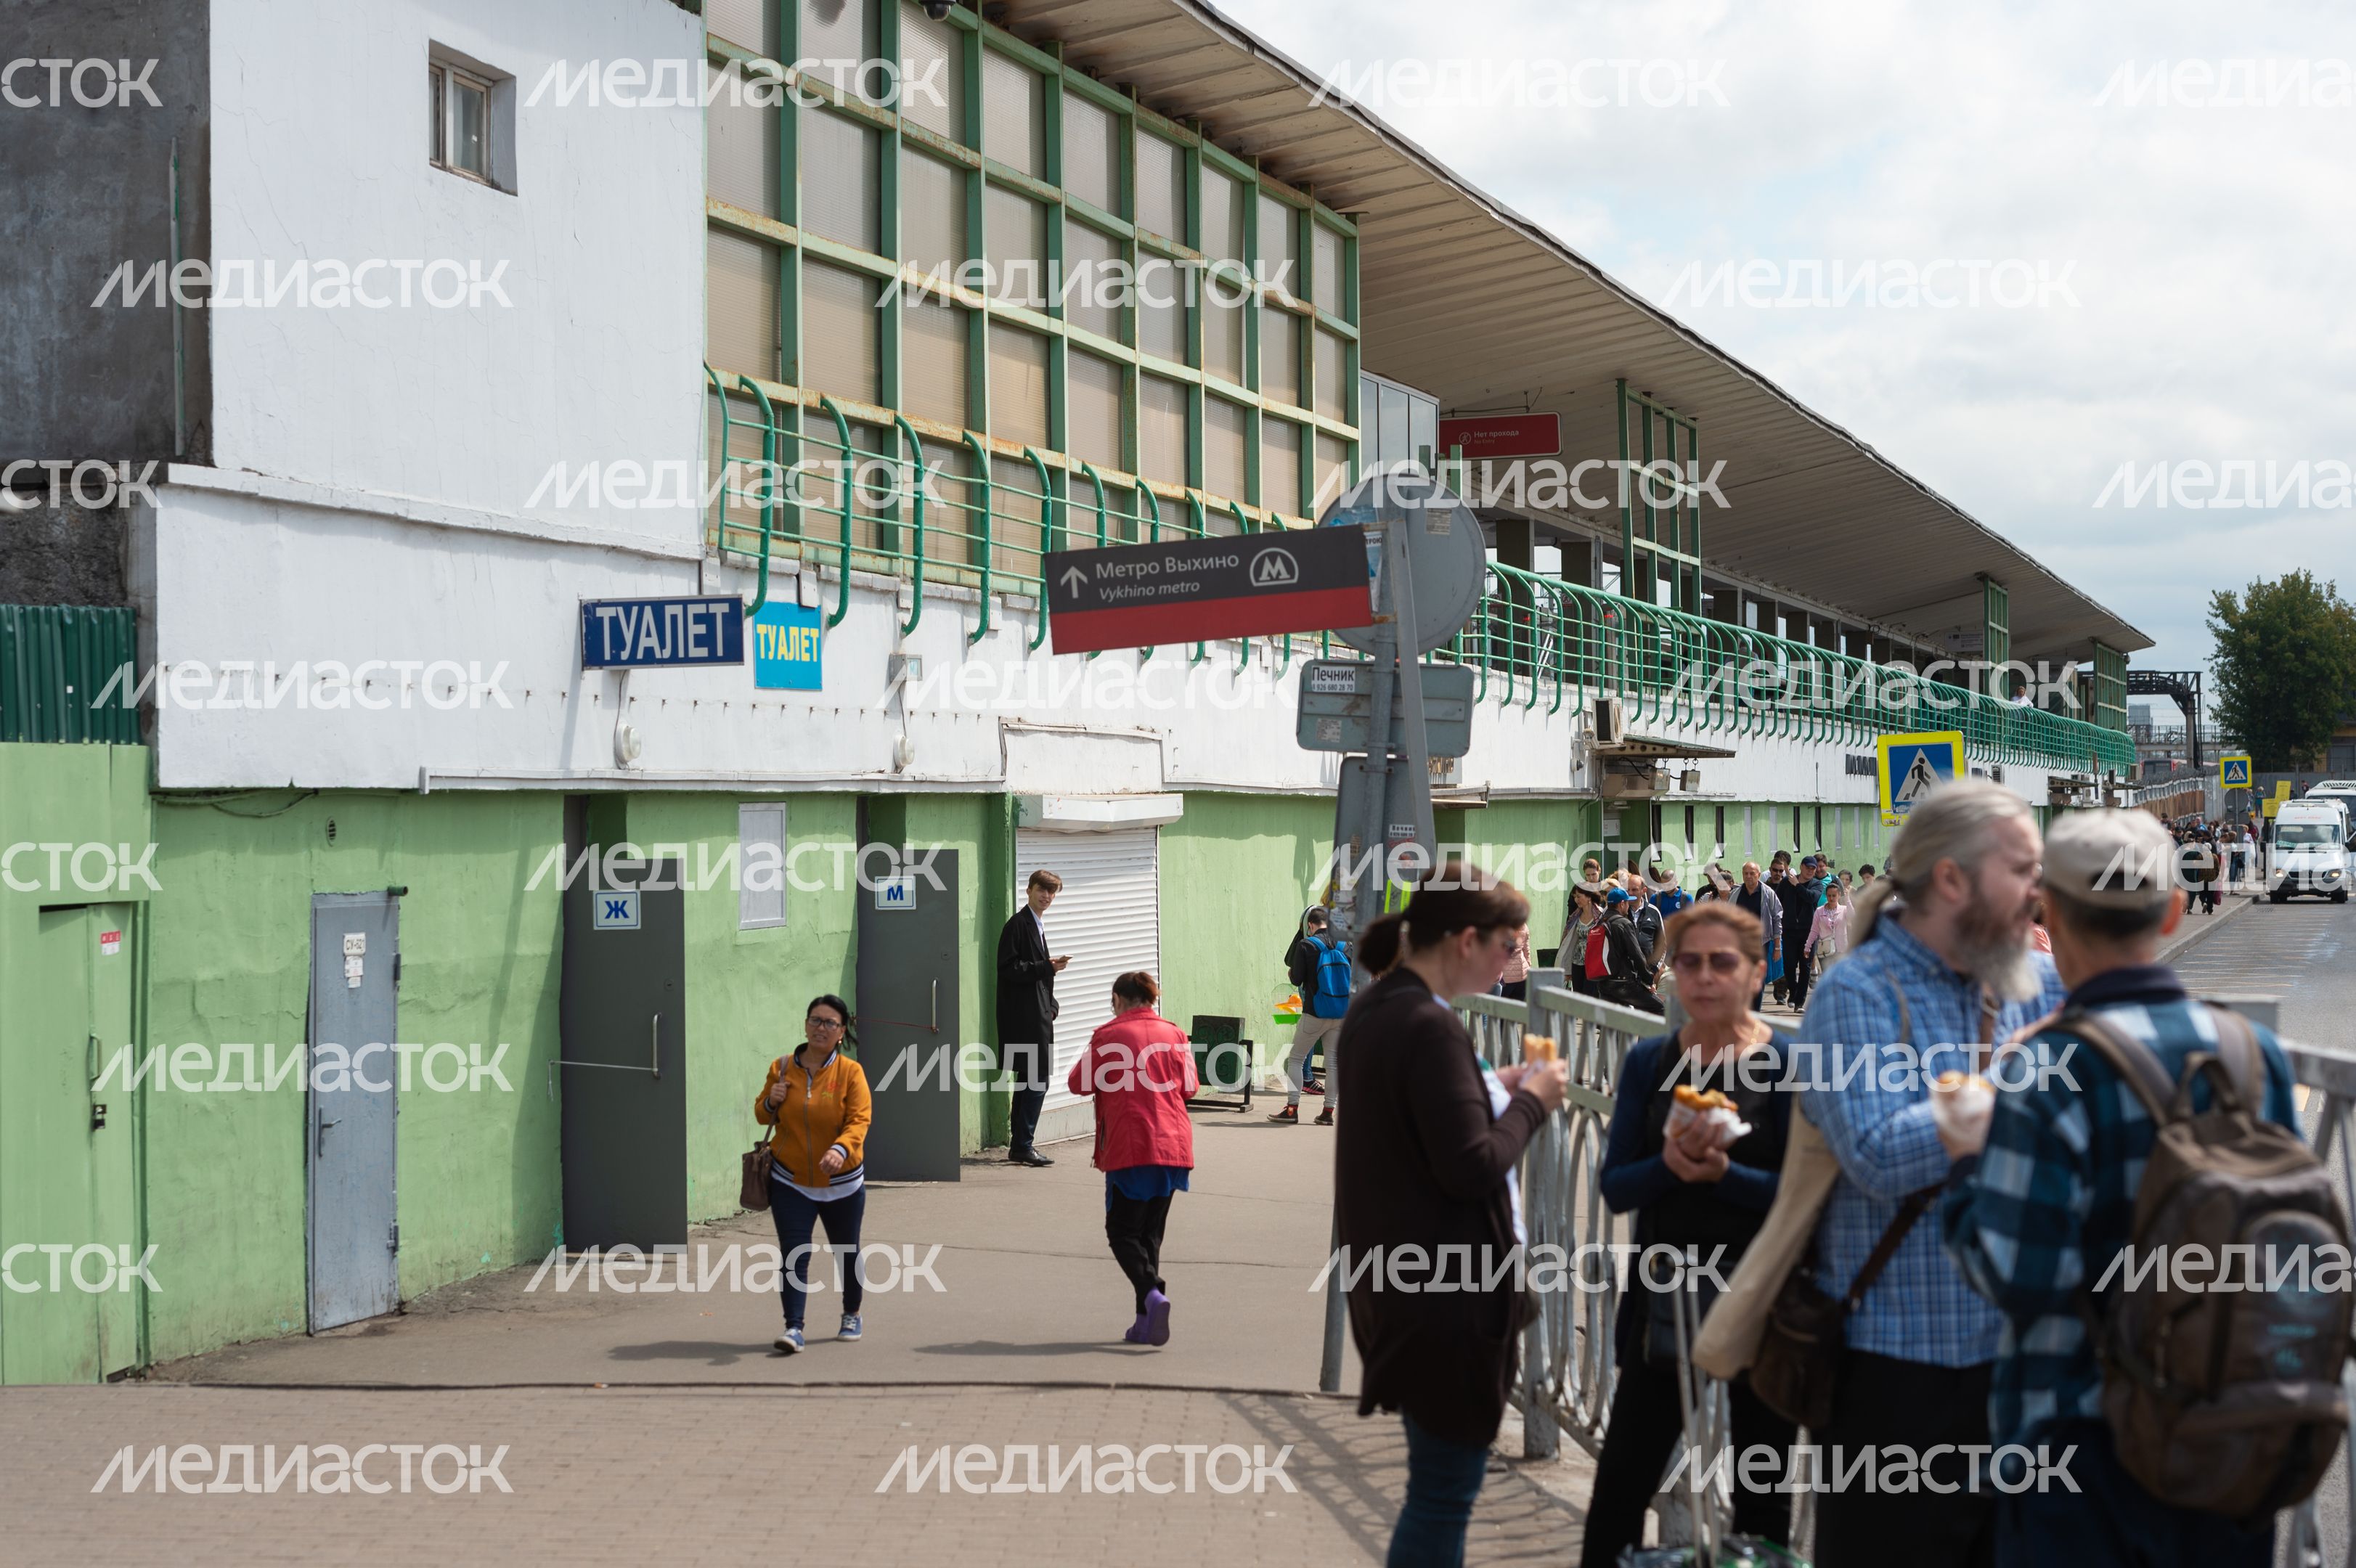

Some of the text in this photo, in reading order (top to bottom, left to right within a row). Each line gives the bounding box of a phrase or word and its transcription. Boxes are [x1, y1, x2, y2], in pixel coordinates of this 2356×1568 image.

[1096, 554, 1240, 580] Метро Выхино
[1098, 581, 1201, 603] Vykhino metro
[596, 603, 729, 661] ТУАЛЕТ
[757, 624, 819, 663] ТУАЛЕТ
[1312, 667, 1354, 681] Печник
[886, 885, 905, 901] М
[605, 899, 629, 920] Ж
